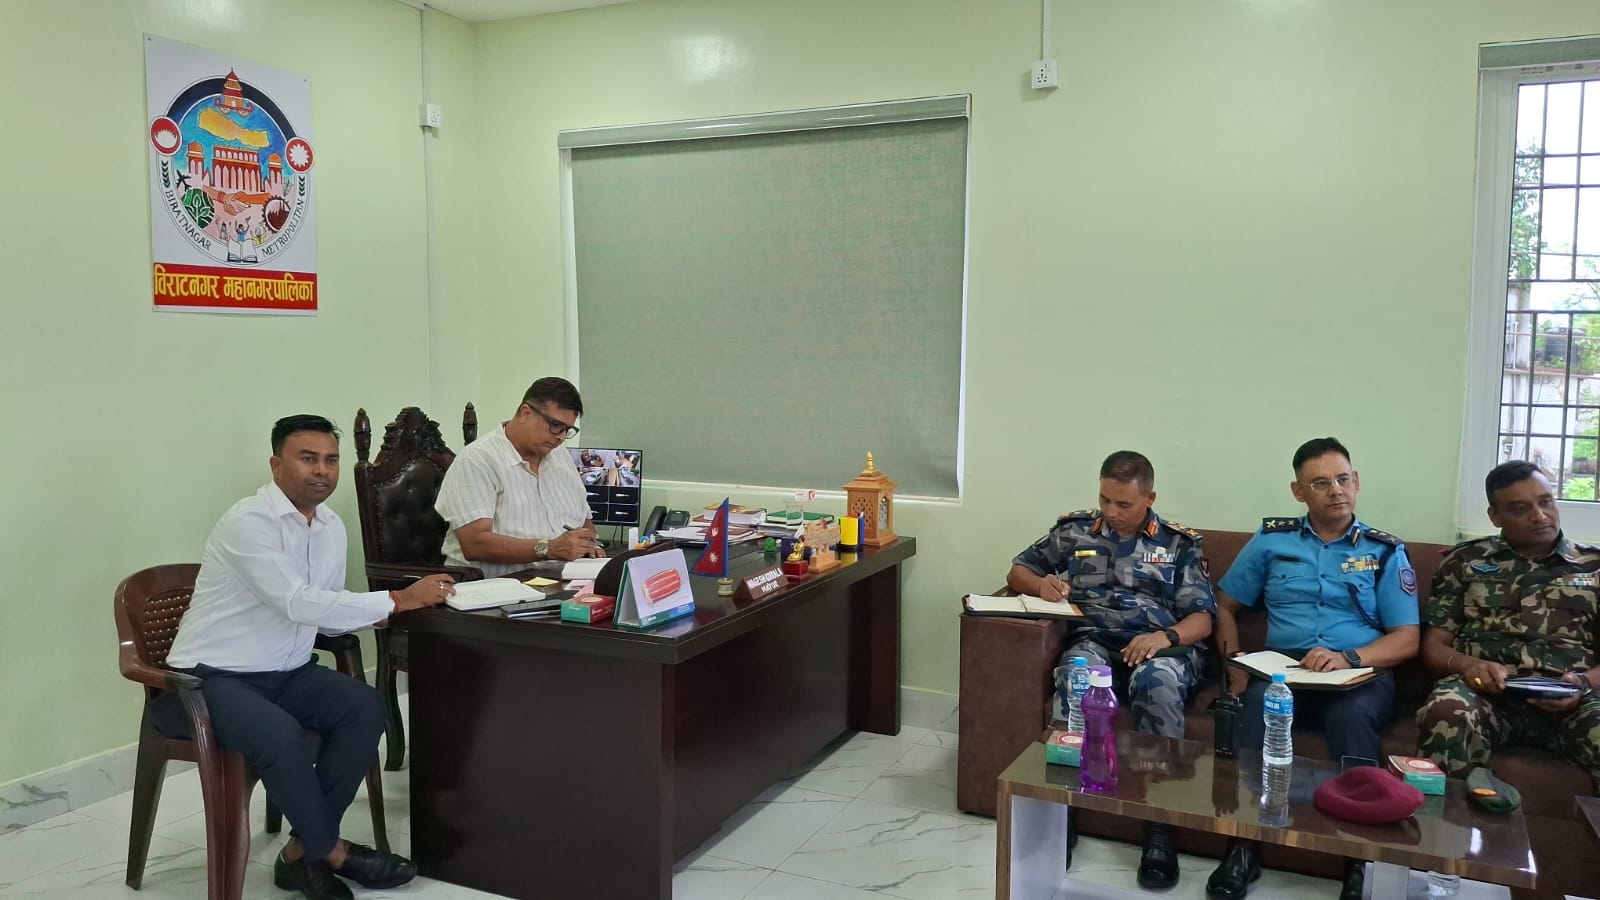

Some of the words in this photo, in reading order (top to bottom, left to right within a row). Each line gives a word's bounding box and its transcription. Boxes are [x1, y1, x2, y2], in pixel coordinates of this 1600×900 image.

[165, 191, 212, 251] BIRATNAGAR
[261, 200, 304, 257] METROPOLITAN
[154, 265, 220, 299] विराटनगर
[223, 273, 314, 302] महानगरपालिका
